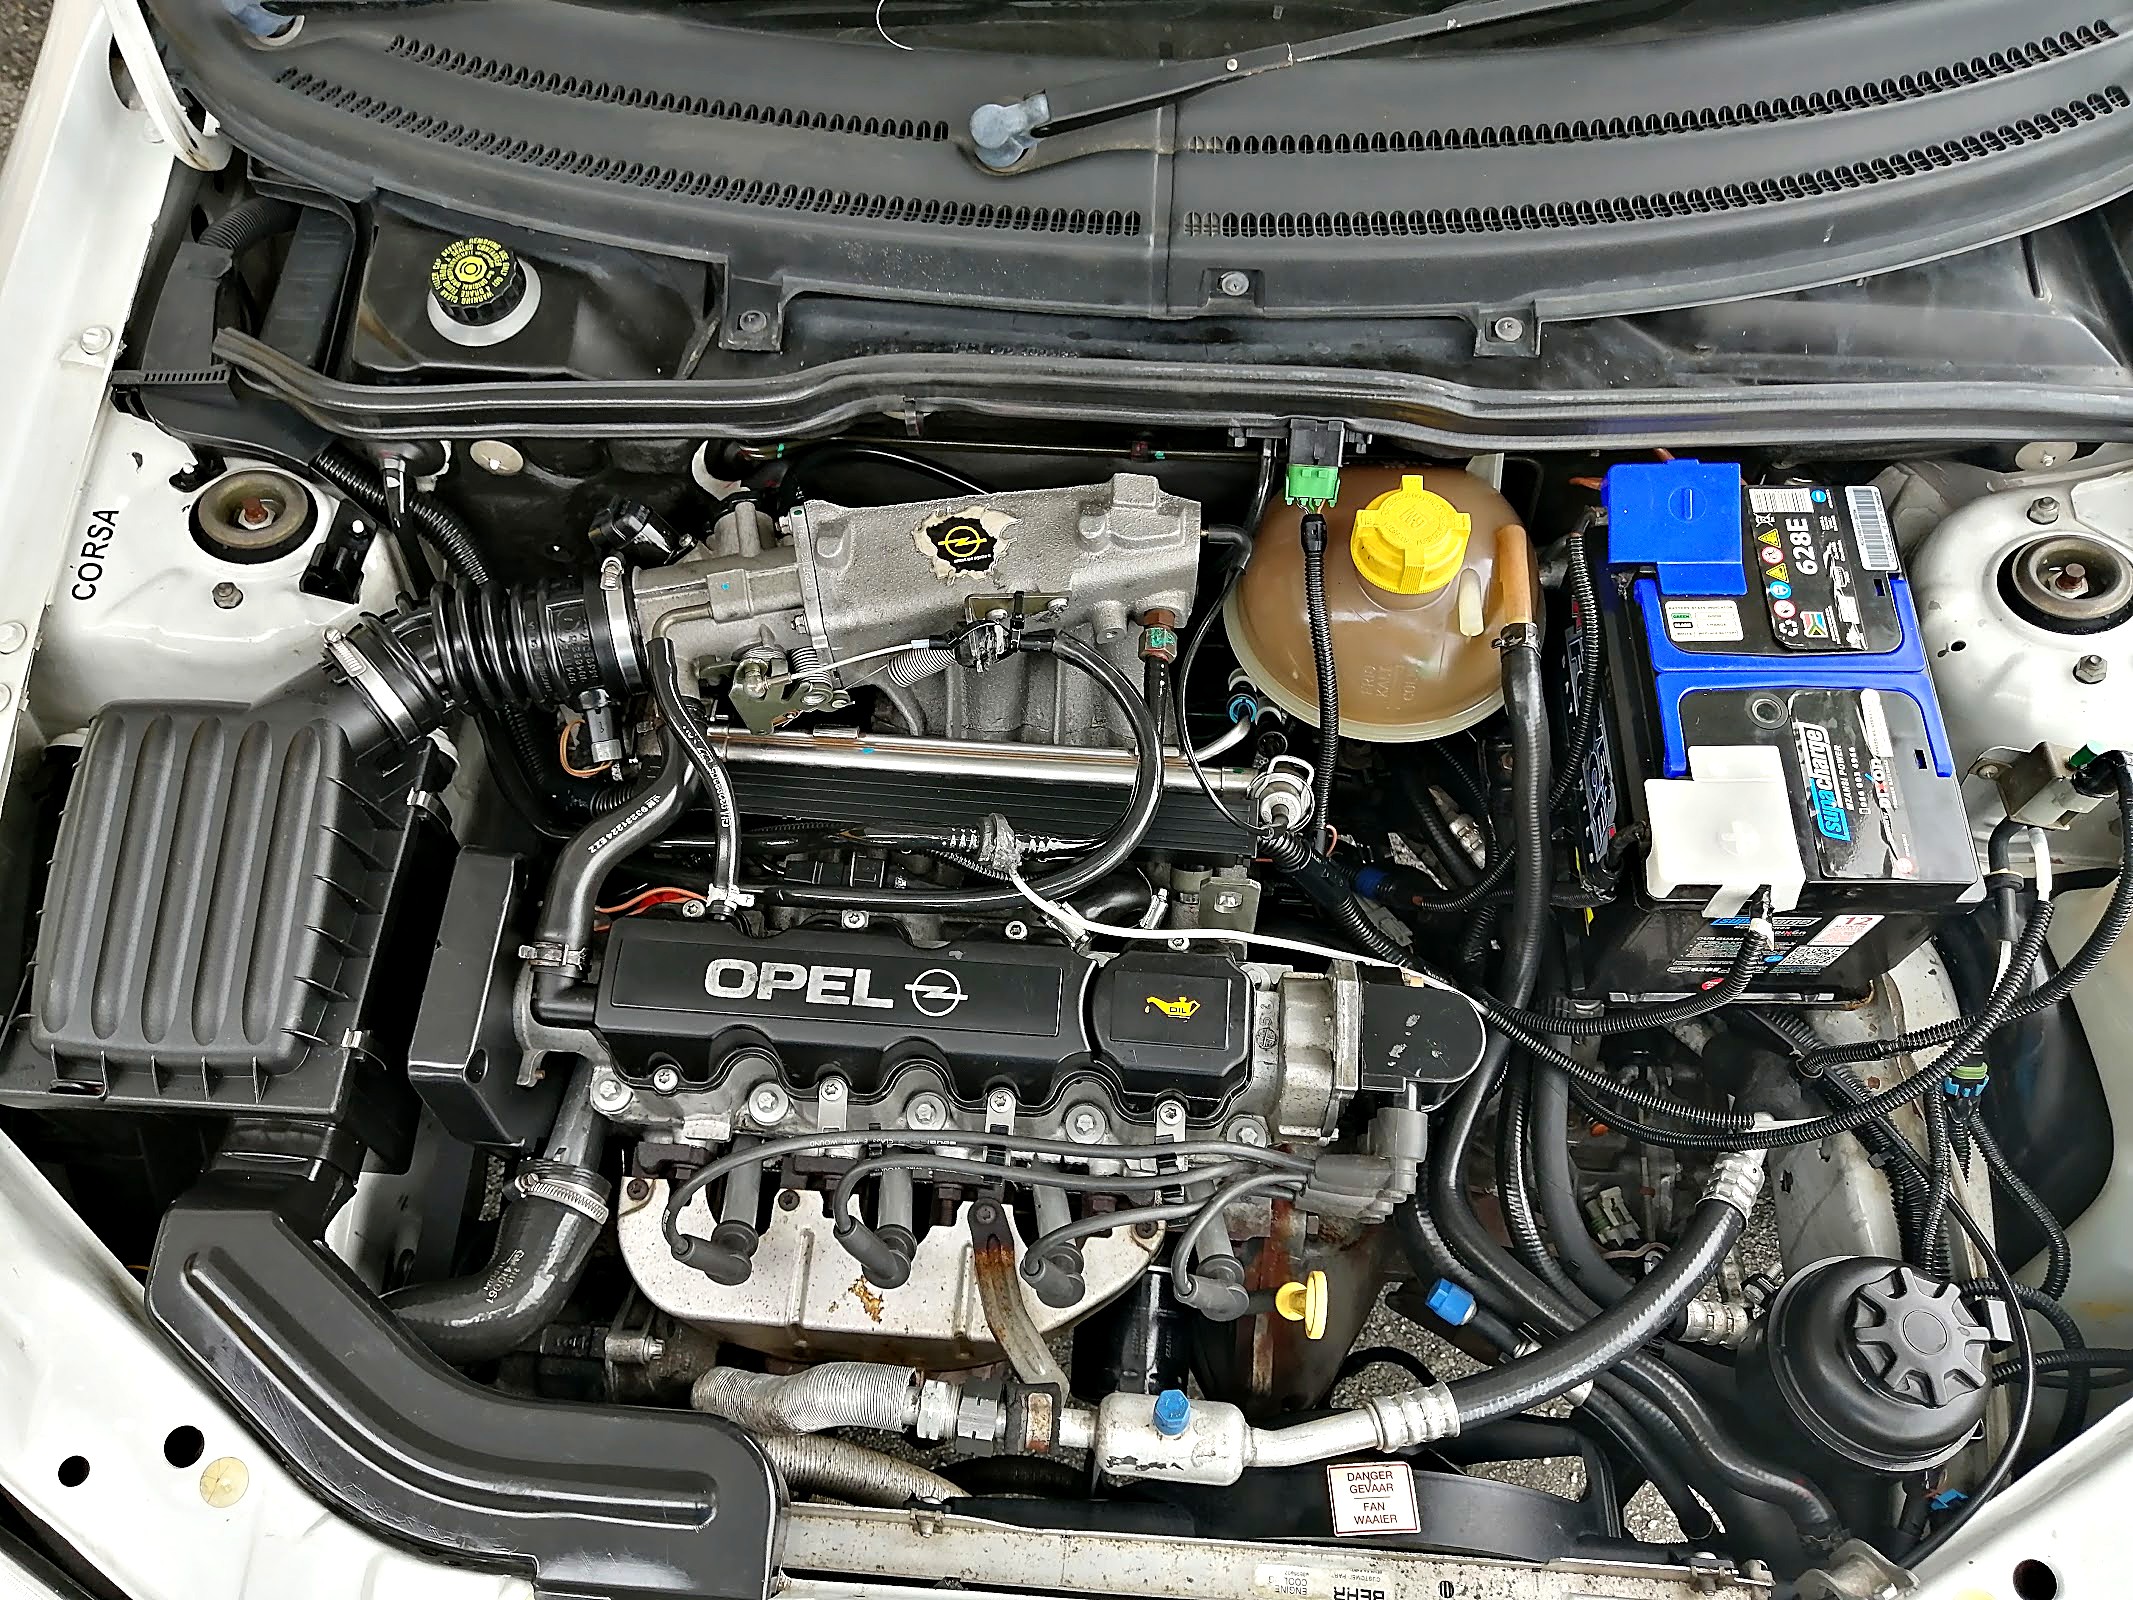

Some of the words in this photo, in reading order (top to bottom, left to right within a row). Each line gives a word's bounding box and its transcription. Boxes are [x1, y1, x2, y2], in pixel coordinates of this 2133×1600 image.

[1785, 518, 1819, 575] 628E
[71, 510, 120, 601] CORSA
[1833, 744, 1849, 777] POWER
[1805, 728, 1843, 833] supacharge
[1844, 916, 1874, 926] 12
[704, 958, 894, 1009] OPEL
[1169, 1006, 1187, 1014] OIL
[1347, 1470, 1394, 1482] DANGER
[1349, 1483, 1394, 1494] GEVAAR
[1363, 1502, 1386, 1512] FAN
[1353, 1514, 1398, 1525] WAAIER
[1275, 1585, 1308, 1596] ENGINE
